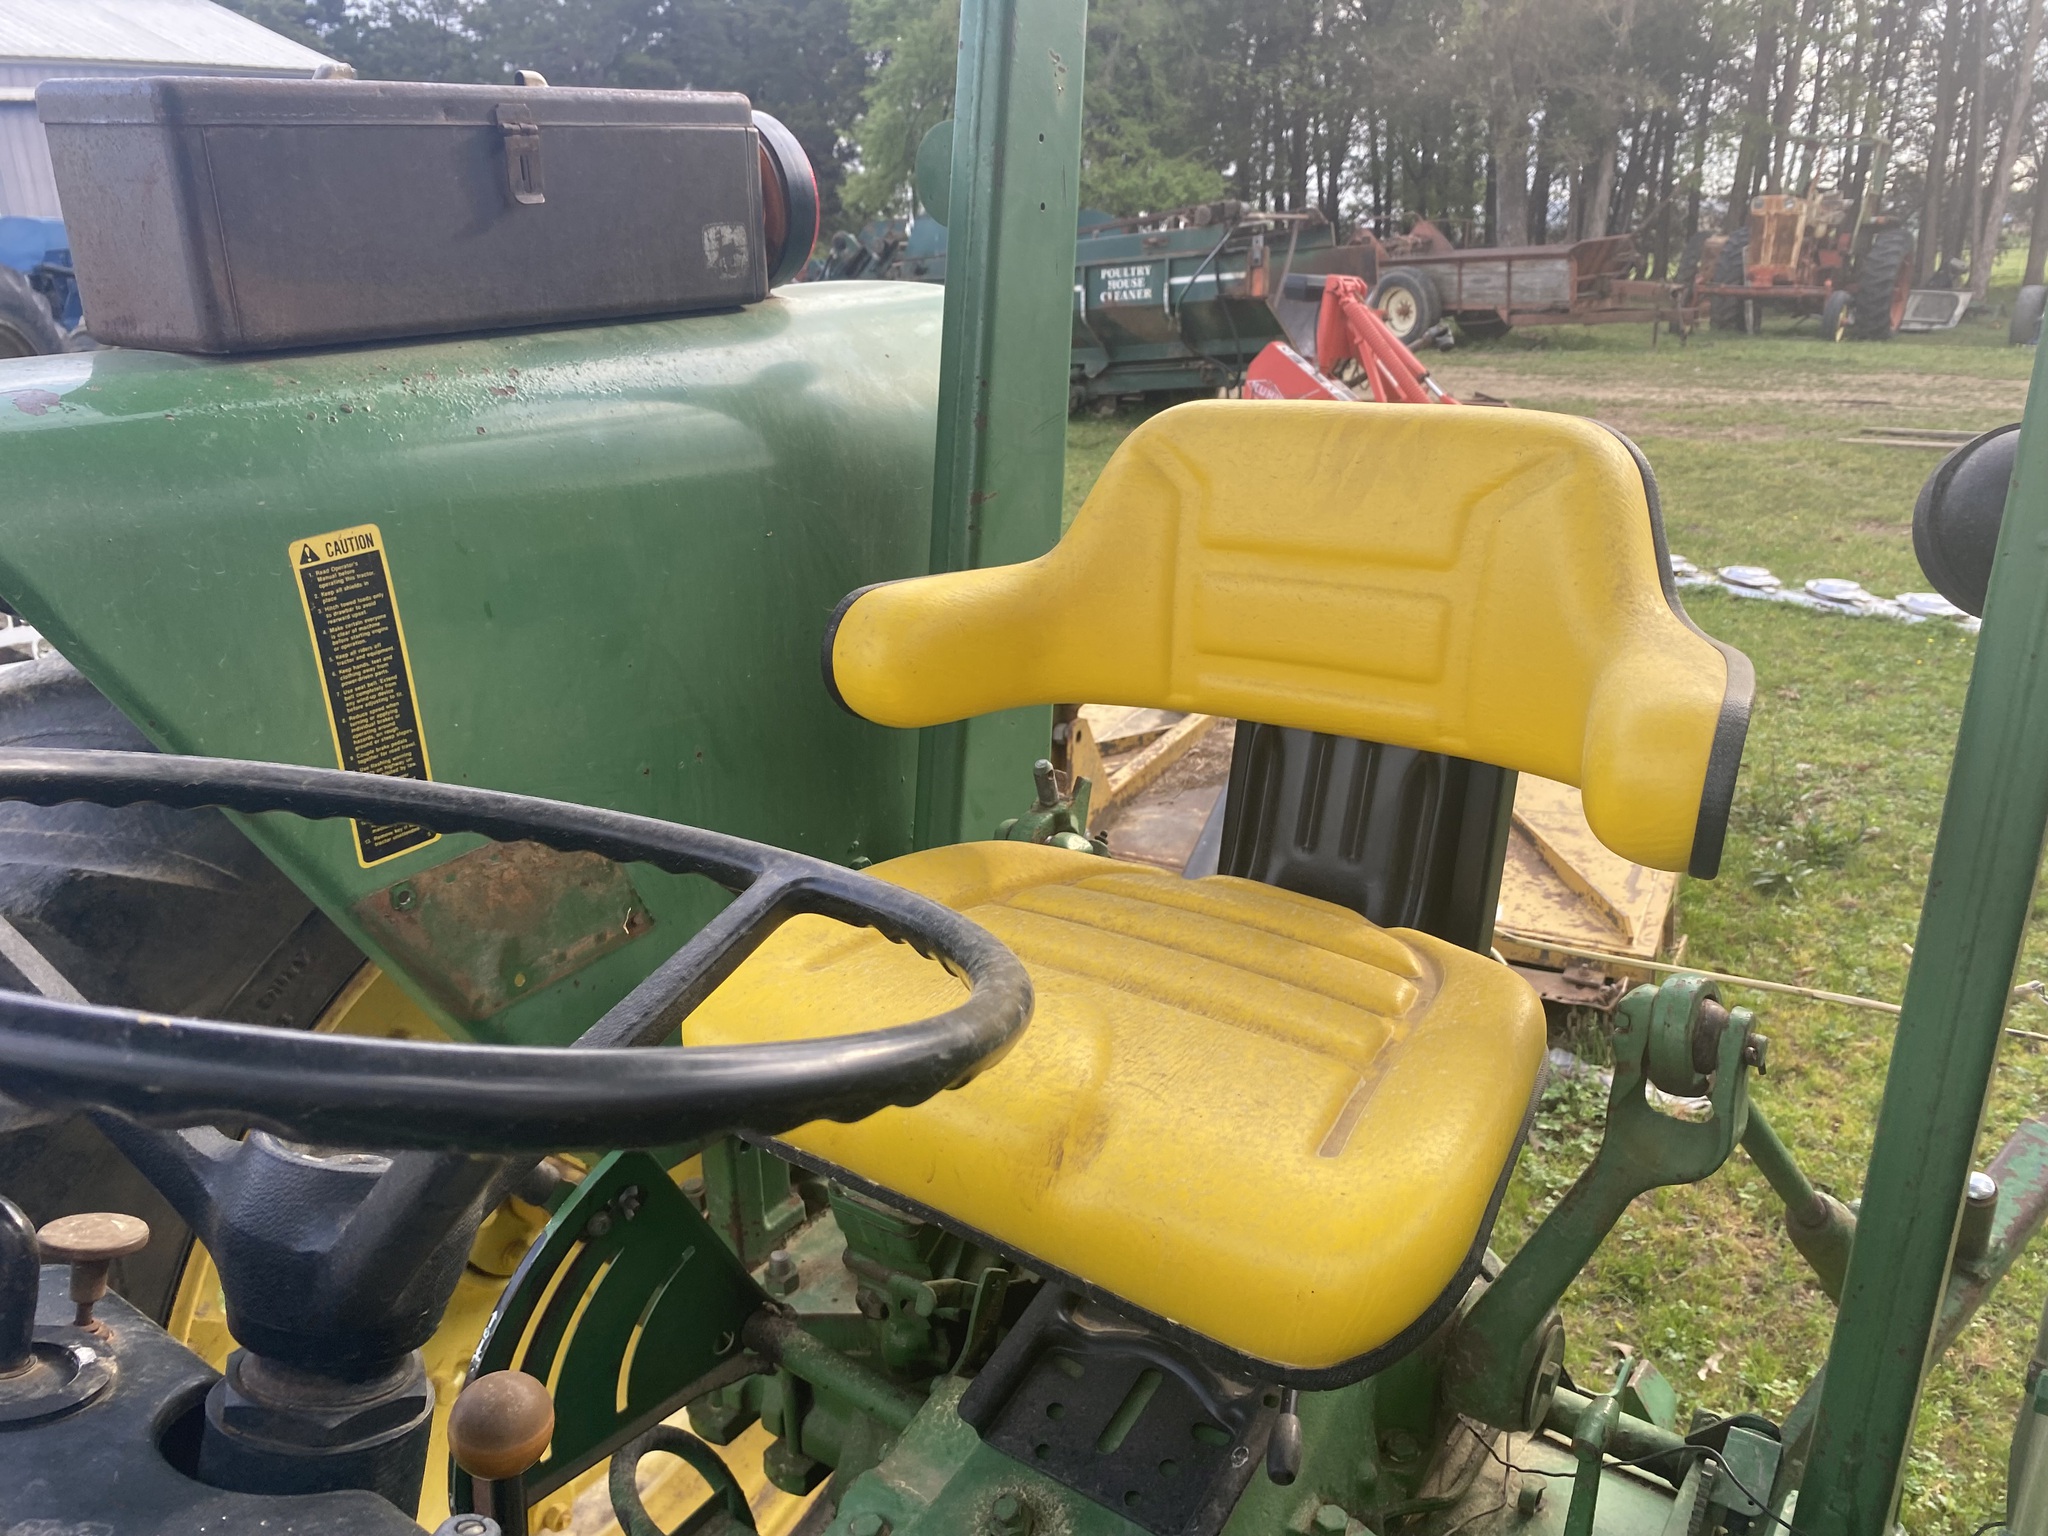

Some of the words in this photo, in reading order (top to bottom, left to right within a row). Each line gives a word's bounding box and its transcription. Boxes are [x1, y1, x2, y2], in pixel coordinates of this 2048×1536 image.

[1100, 265, 1151, 279] POULTRY
[1107, 277, 1145, 290] HOUSE
[1100, 289, 1152, 302] CLEANER
[325, 533, 374, 557] CAUTION
